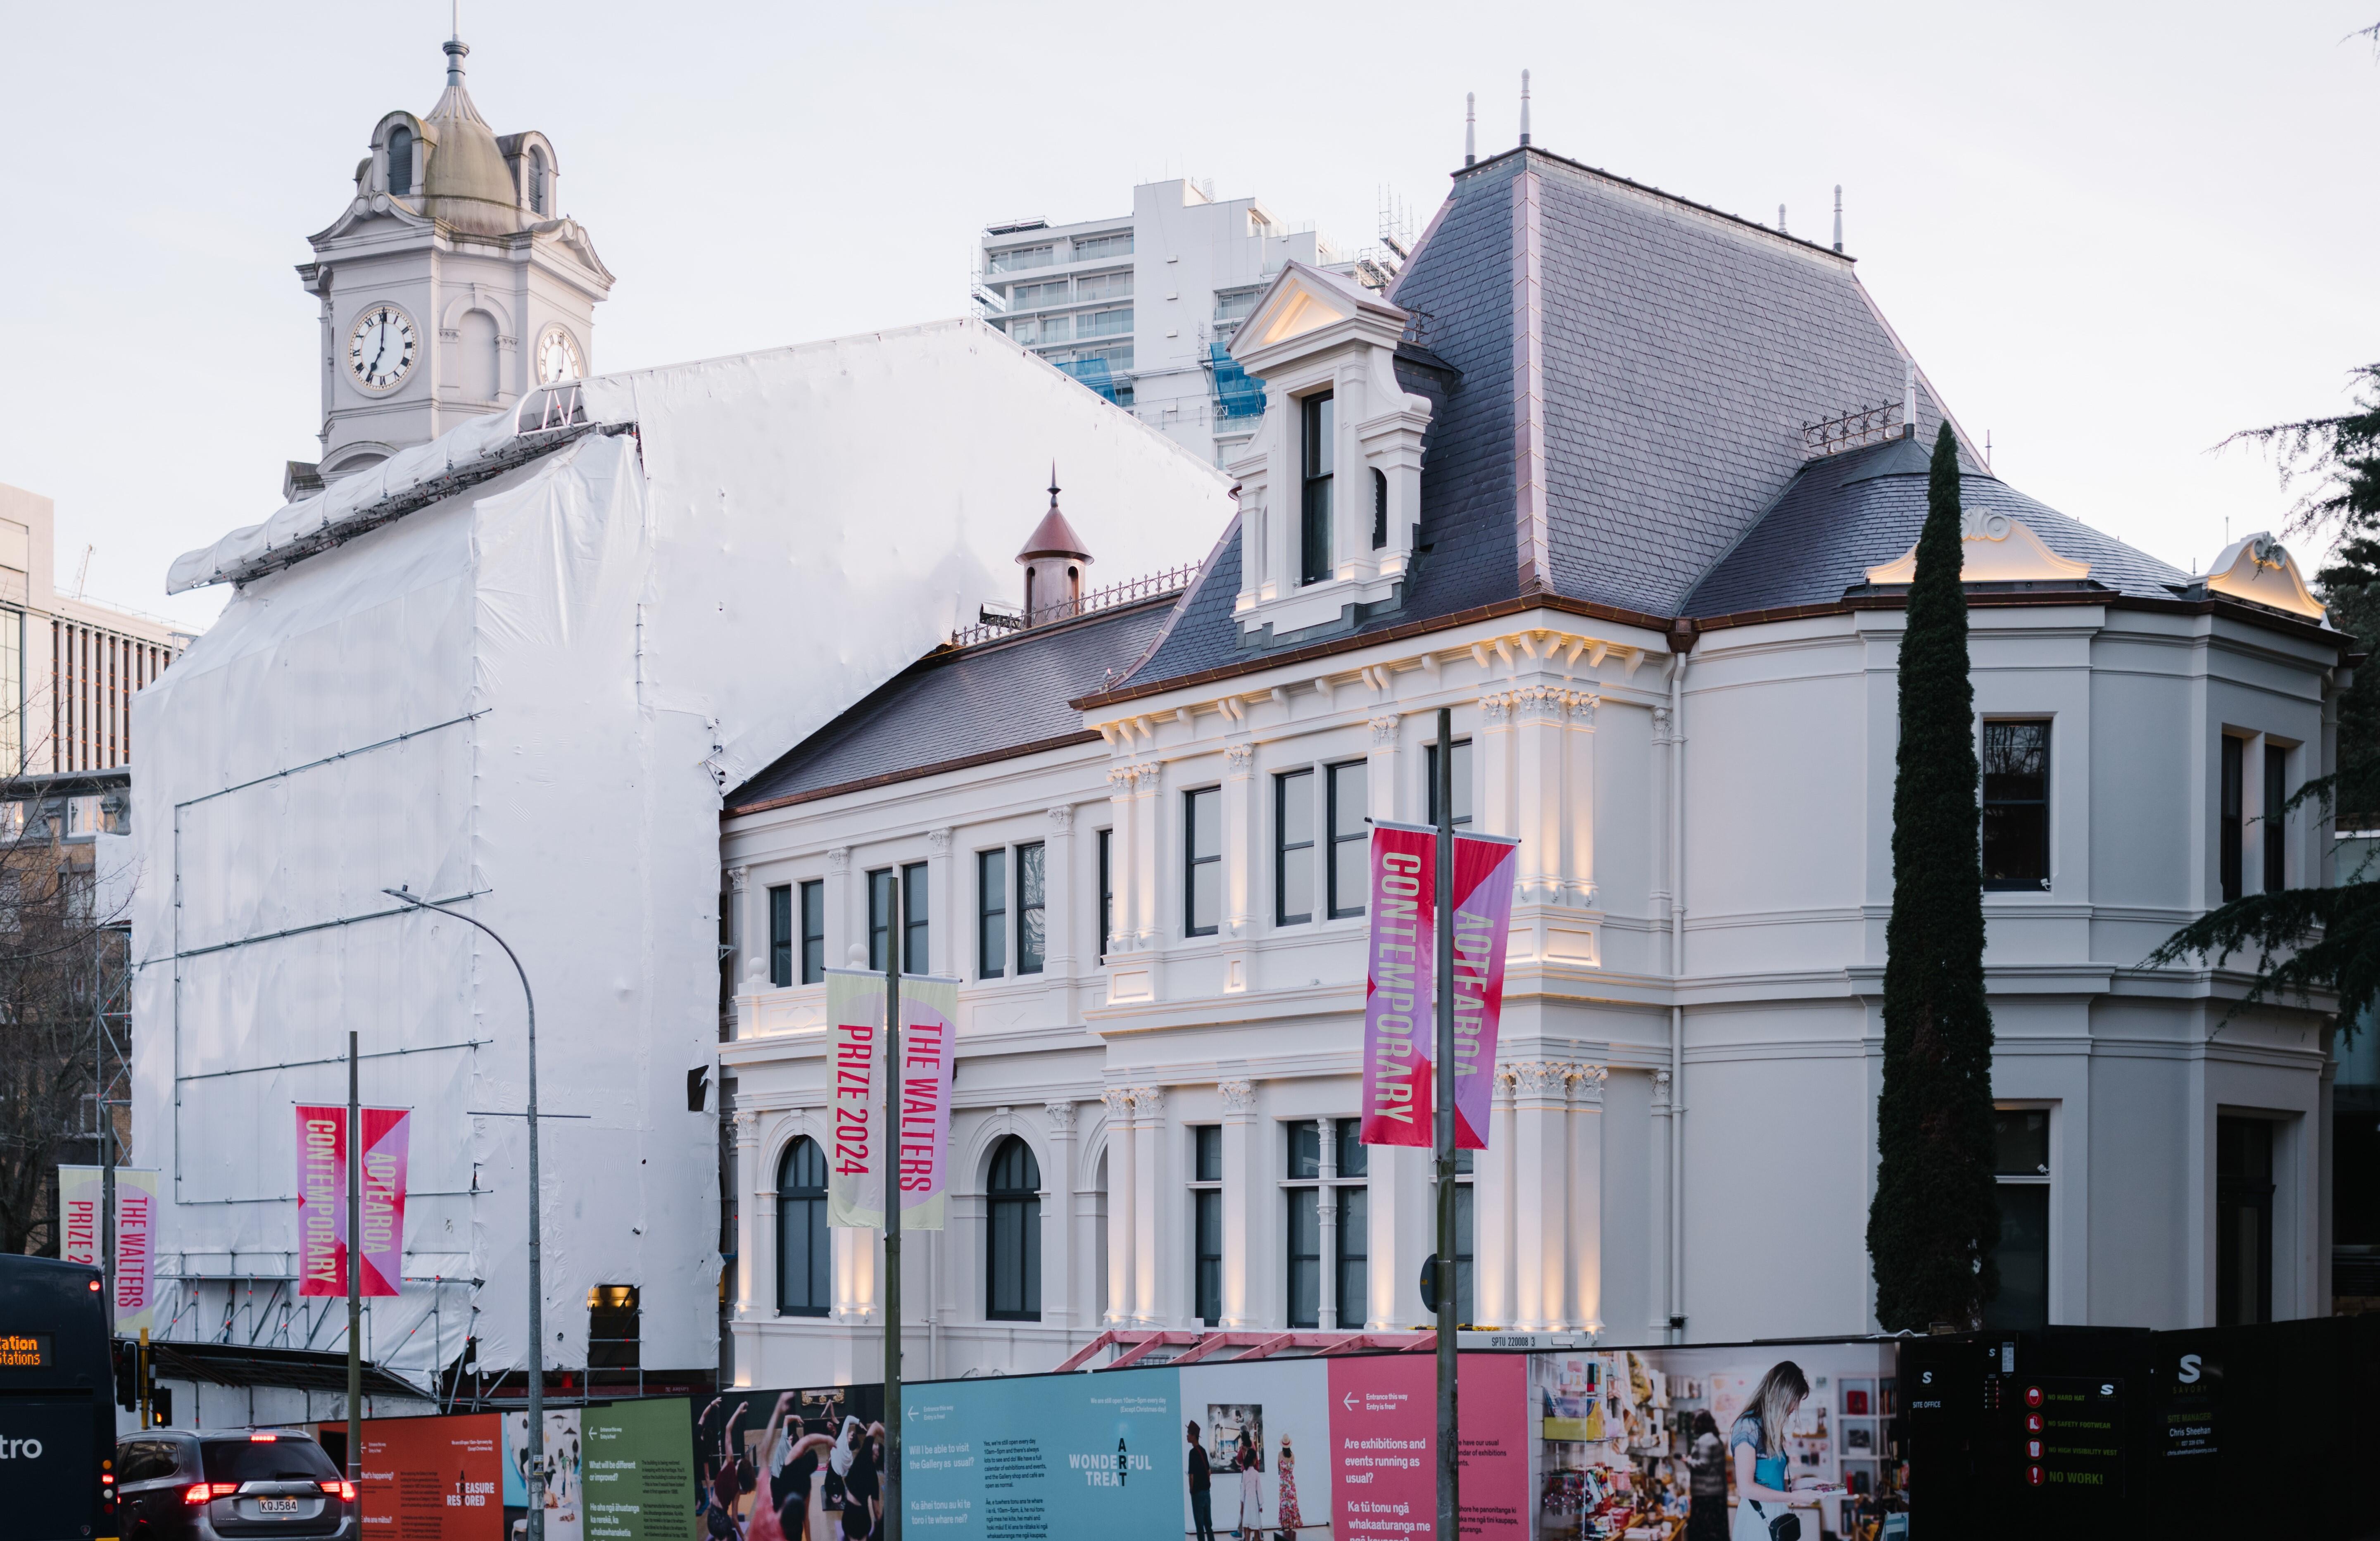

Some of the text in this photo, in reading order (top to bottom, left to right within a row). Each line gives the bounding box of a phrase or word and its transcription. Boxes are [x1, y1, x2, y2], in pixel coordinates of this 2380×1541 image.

[1374, 852, 1422, 1125] CONTEMPORARY
[1453, 910, 1494, 1076] AOTEAROA
[835, 1024, 873, 1176] PRIZE 2024
[900, 1022, 943, 1192] THE WALTERS
[306, 1119, 337, 1283] CONTEMPORARY
[364, 1152, 397, 1254] AOTEAROA
[68, 1201, 93, 1249] PRIZE
[118, 1197, 148, 1307] THE WALTERS
[0, 1335, 38, 1350] ation
[1492, 1336, 1535, 1347] SPTU 220008 3
[2172, 1384, 2208, 1395] SAVORY
[2168, 1414, 2181, 1423] SITE
[2169, 1426, 2211, 1437] Chris Sheehan
[909, 1442, 969, 1455] Will I be able to visit
[1344, 1438, 1425, 1449] Are exhibitions and
[615, 1460, 636, 1469] different
[909, 1460, 920, 1469] the
[921, 1459, 943, 1470] Gallery
[953, 1456, 974, 1467] usual?
[1068, 1454, 1152, 1470] WONDERFUL
[1345, 1455, 1420, 1469] events running as
[594, 1473, 618, 1482] improved?
[1085, 1471, 1127, 1486] TREAT
[1346, 1472, 1373, 1483] usual?
[2049, 1471, 2104, 1485] NO WORK!
[261, 1501, 297, 1511] KQJ584
[446, 1495, 485, 1507] RESTORED
[911, 1501, 920, 1510] Ka
[920, 1500, 933, 1510] āhei
[934, 1501, 948, 1509] tonu
[957, 1499, 963, 1508] ki
[964, 1499, 970, 1508] te
[1348, 1501, 1409, 1516] Ka tū tonu ngā
[911, 1513, 968, 1524] toro i te whare nei?
[1348, 1518, 1430, 1533] whakaaturanga me
